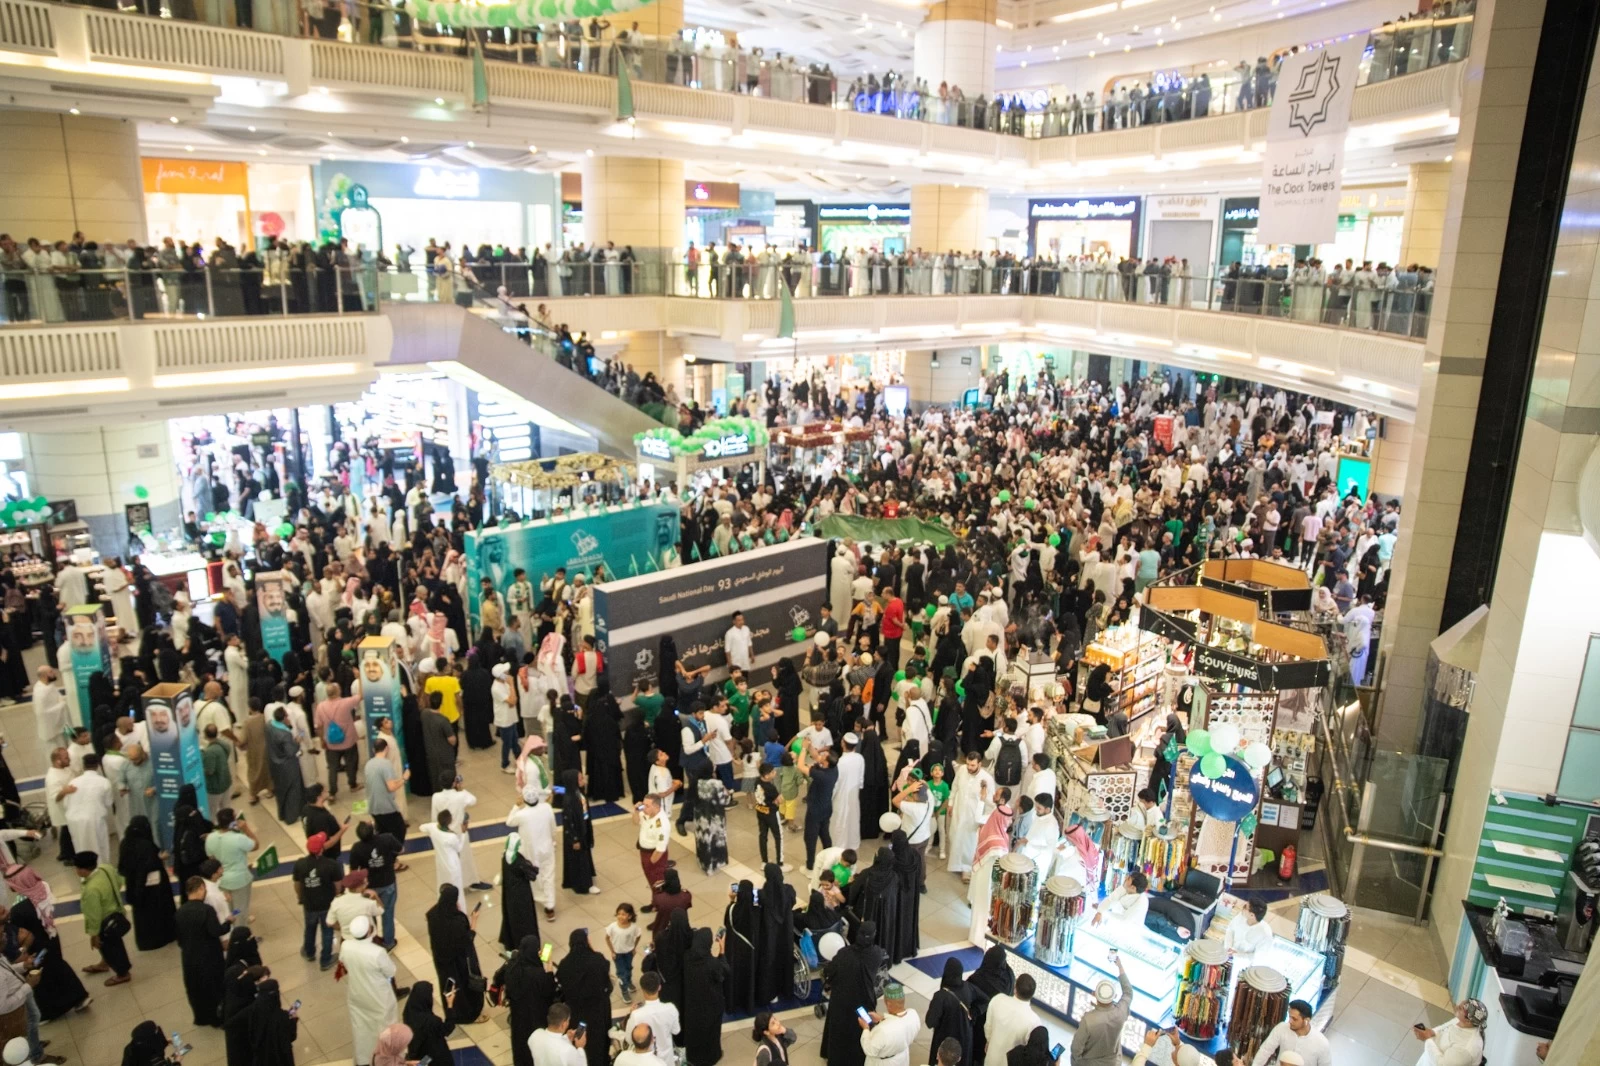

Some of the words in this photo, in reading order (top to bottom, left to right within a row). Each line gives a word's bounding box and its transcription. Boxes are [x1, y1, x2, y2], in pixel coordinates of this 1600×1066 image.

[1267, 183, 1282, 196] The
[1283, 182, 1305, 194] Clock
[1307, 180, 1336, 193] Towers
[658, 594, 678, 605] Saudi
[677, 585, 703, 600] National
[703, 584, 716, 594] Day
[717, 577, 732, 591] 93
[1198, 654, 1259, 681] SOUVENIRS
